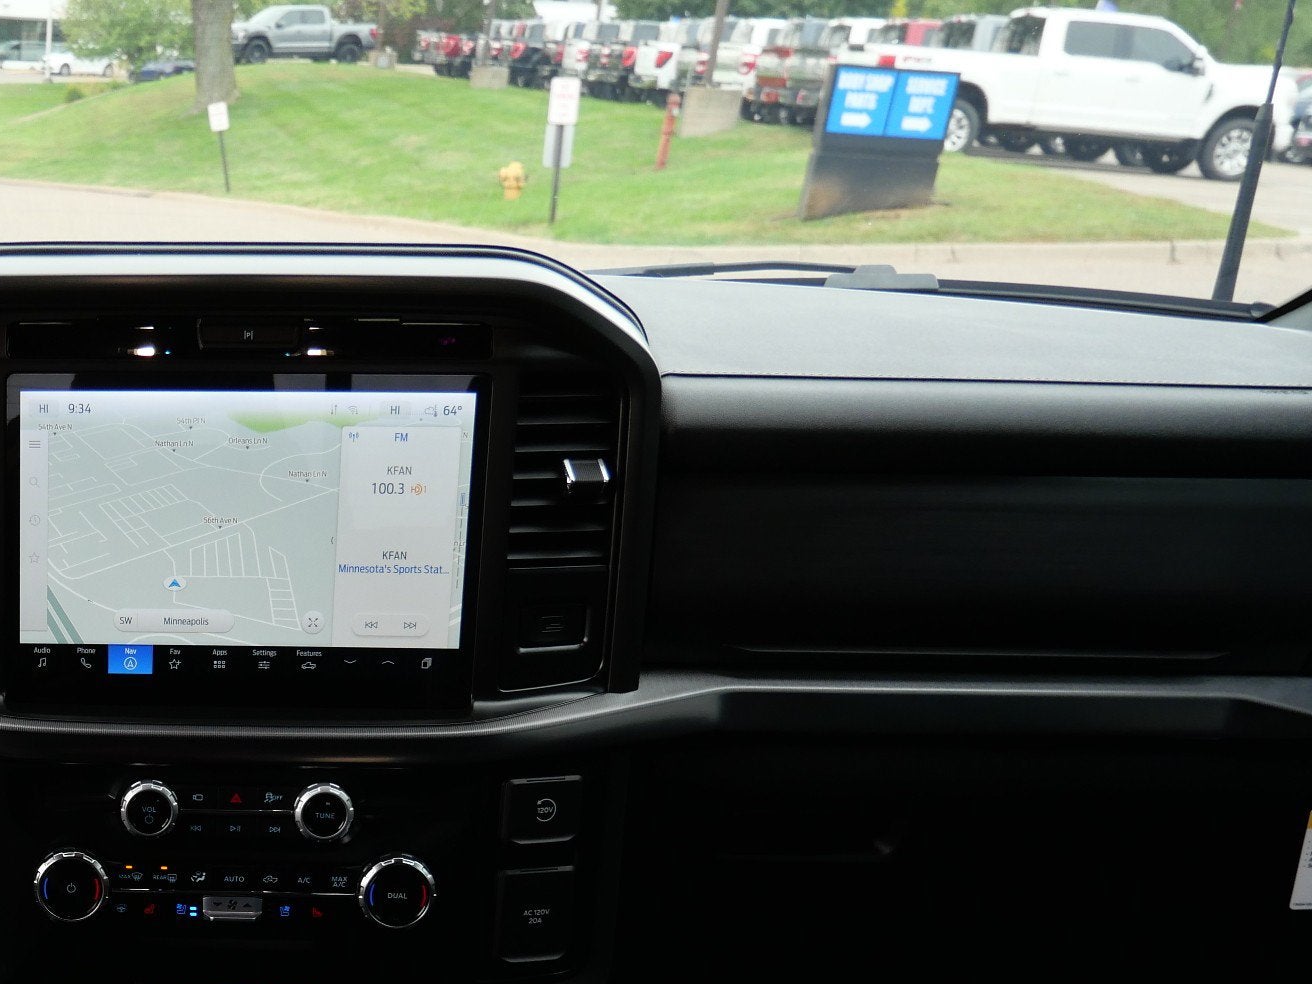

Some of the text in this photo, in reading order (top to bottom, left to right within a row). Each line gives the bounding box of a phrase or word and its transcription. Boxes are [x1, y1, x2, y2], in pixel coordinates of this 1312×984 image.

[68, 403, 92, 414] 9:34
[54, 423, 66, 431] Ave
[228, 437, 252, 445] Orleans
[394, 433, 408, 442] FM
[154, 439, 178, 448] Nathan
[288, 470, 312, 478] Nathan
[387, 466, 412, 475] KFAN
[372, 482, 405, 495] 100.3
[382, 551, 407, 560] KFAN
[338, 564, 392, 574] Minnesota's
[393, 565, 422, 576] Sports
[119, 617, 132, 625] SW
[163, 617, 209, 627] Minneapolis
[212, 649, 228, 657] Apps
[252, 649, 277, 657] Settings
[296, 649, 322, 657] Features
[315, 812, 336, 820] TUNE
[223, 875, 245, 883] AUTO
[297, 876, 311, 884] A/C
[387, 892, 408, 900] DUAL
[534, 908, 550, 916] 120V
